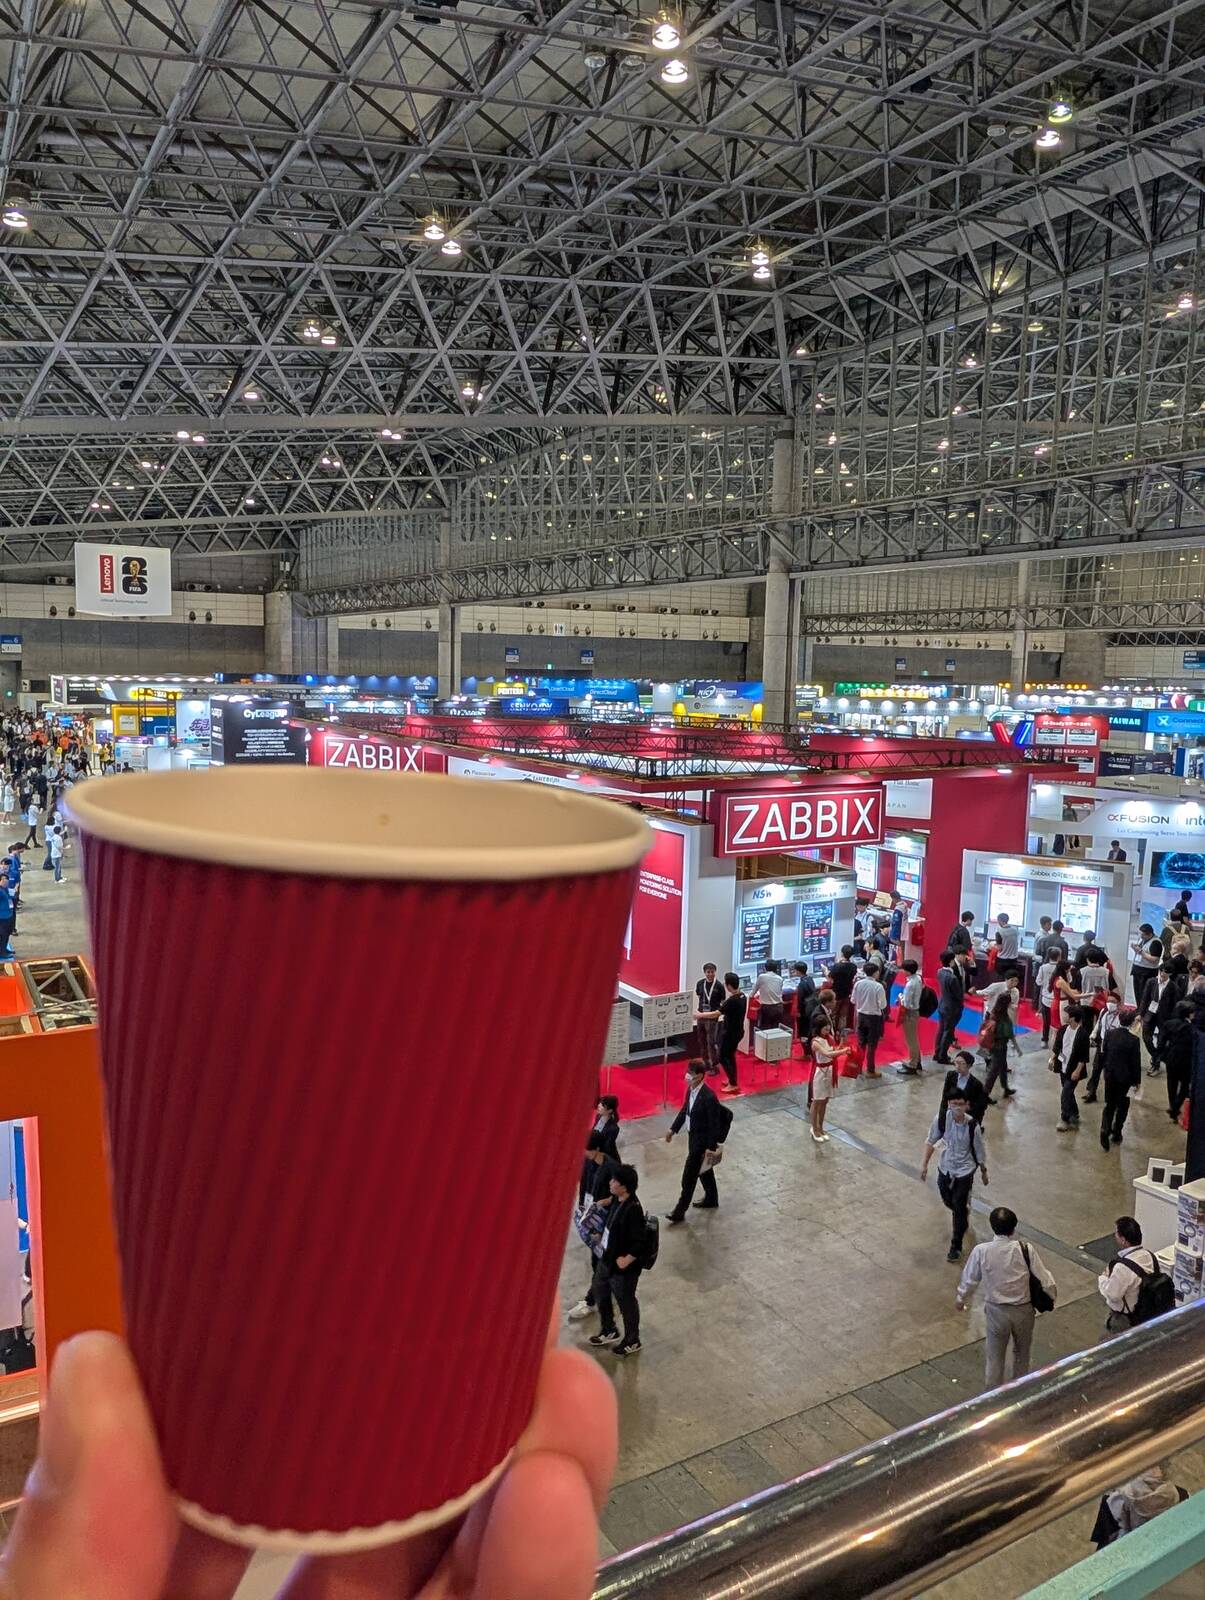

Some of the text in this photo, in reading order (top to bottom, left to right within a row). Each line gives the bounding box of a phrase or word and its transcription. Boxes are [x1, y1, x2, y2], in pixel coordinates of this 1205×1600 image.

[103, 558, 112, 591] Lenovo
[589, 688, 618, 696] DirectCloud
[1108, 716, 1141, 726] TAIWAN
[327, 741, 420, 773] ZABBIX
[731, 797, 876, 845] ZABBIX
